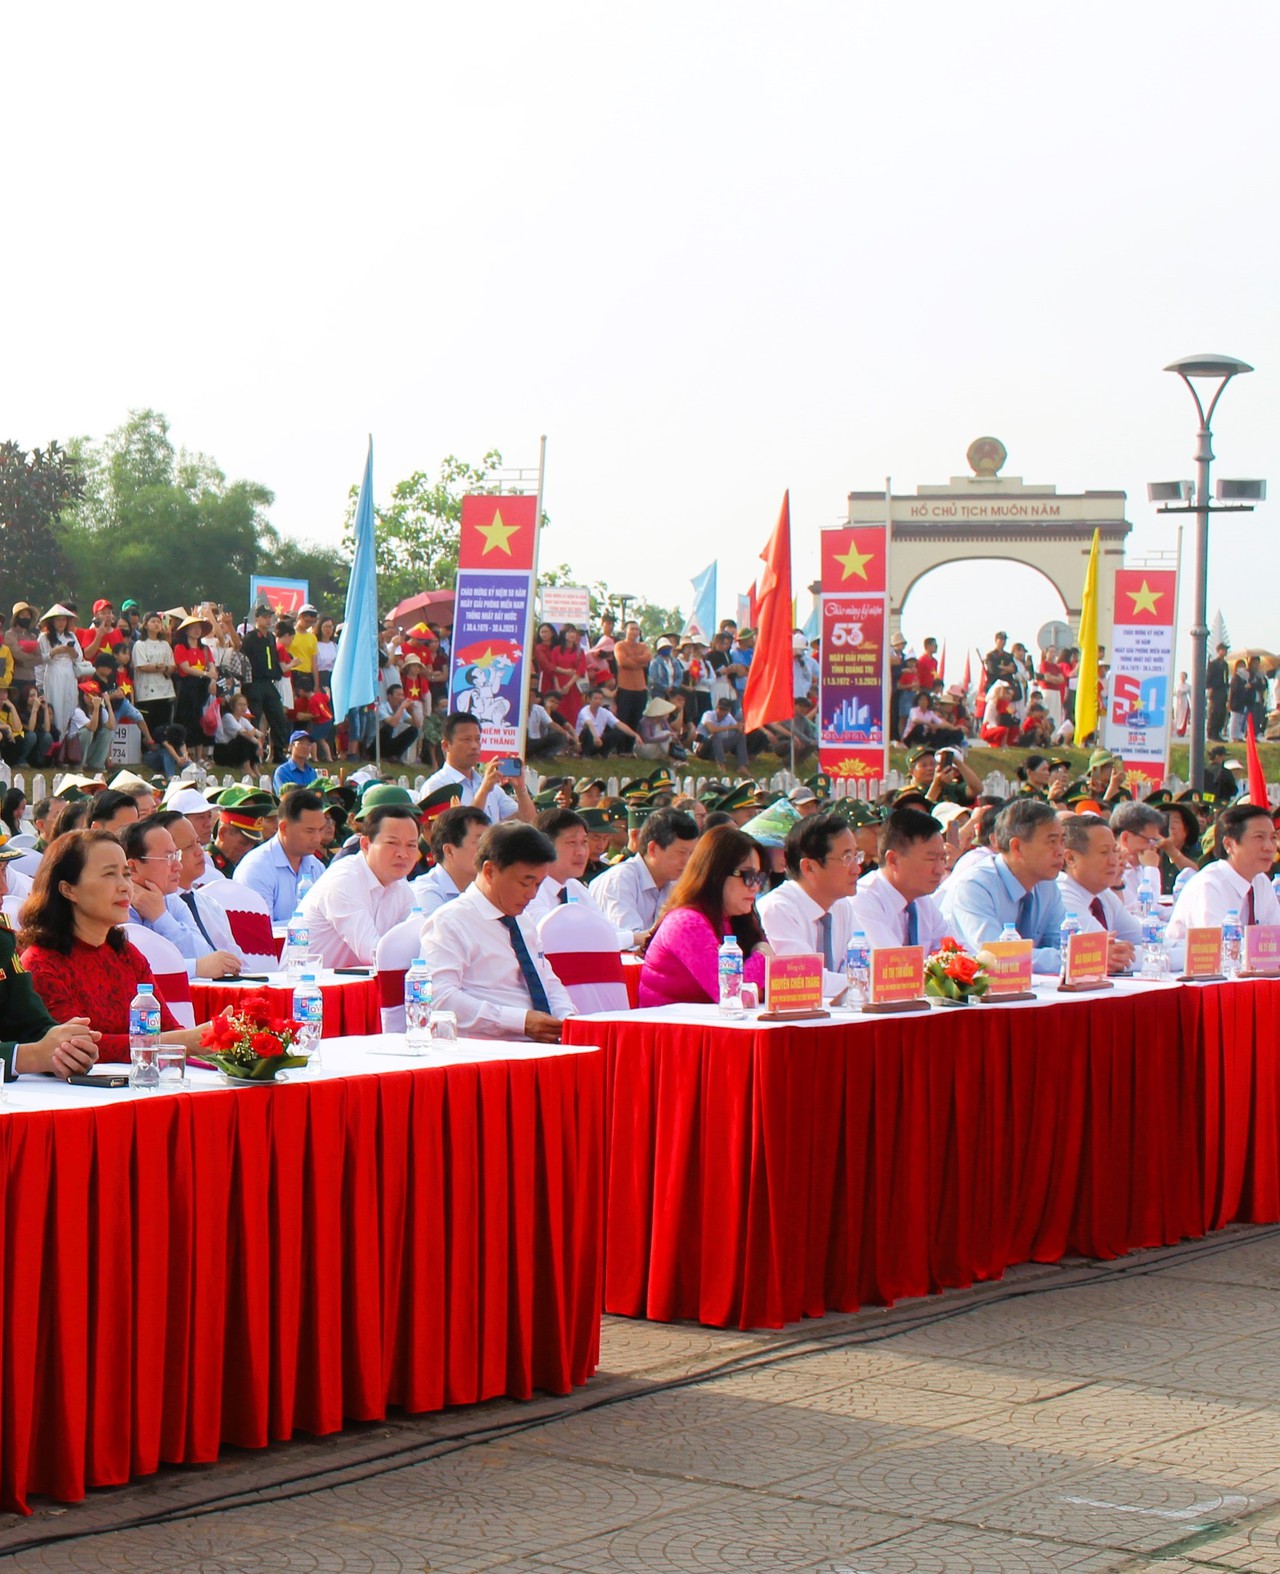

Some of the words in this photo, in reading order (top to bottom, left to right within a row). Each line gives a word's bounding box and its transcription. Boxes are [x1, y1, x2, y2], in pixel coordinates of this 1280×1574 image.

[932, 502, 957, 516] CHỦ
[961, 506, 987, 518] TỊCH
[991, 504, 1028, 516] MUÔN
[1031, 503, 1060, 516] NĂM
[831, 622, 864, 646] 53
[112, 748, 126, 758] 734
